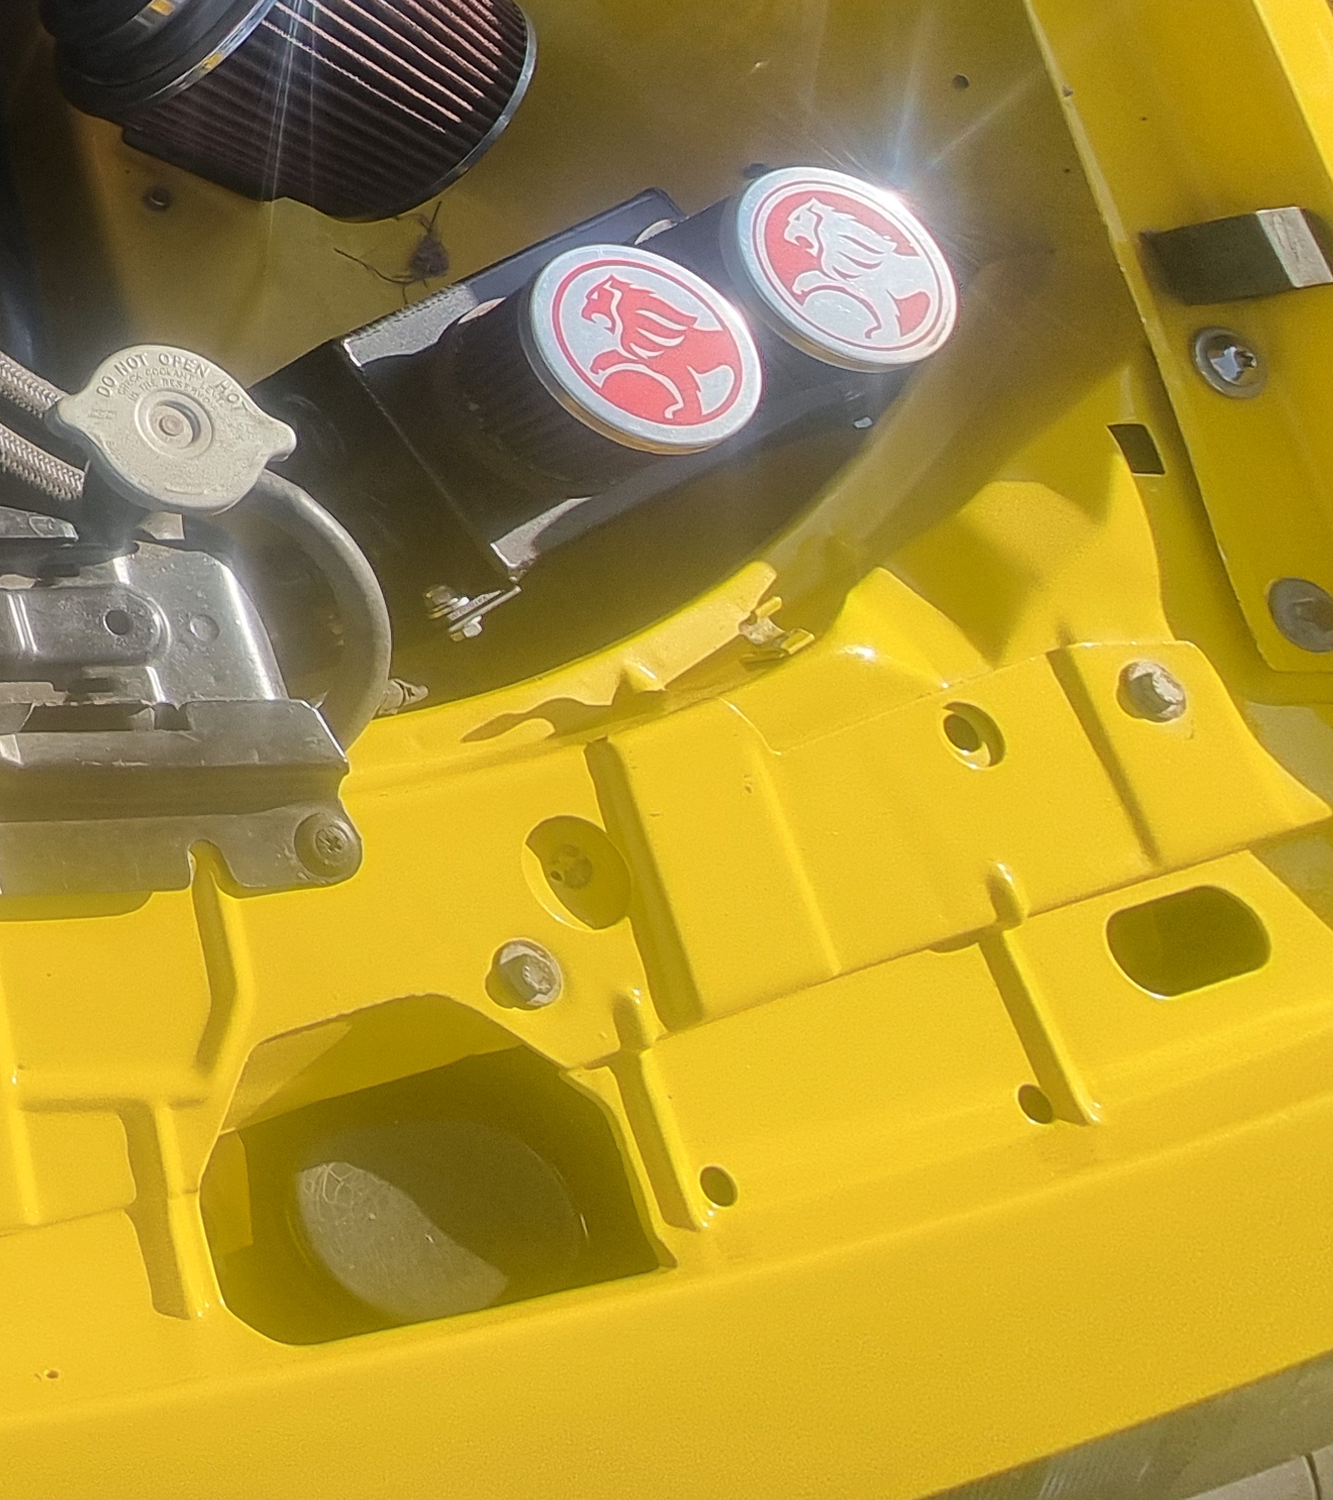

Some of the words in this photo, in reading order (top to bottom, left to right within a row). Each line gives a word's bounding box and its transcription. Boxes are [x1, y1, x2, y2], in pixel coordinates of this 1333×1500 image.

[146, 367, 195, 382] COOLANT
[96, 375, 115, 399] DO
[114, 353, 149, 376] NOT
[158, 353, 212, 379] OPEN
[214, 379, 249, 414] HOT
[139, 378, 159, 391] THE
